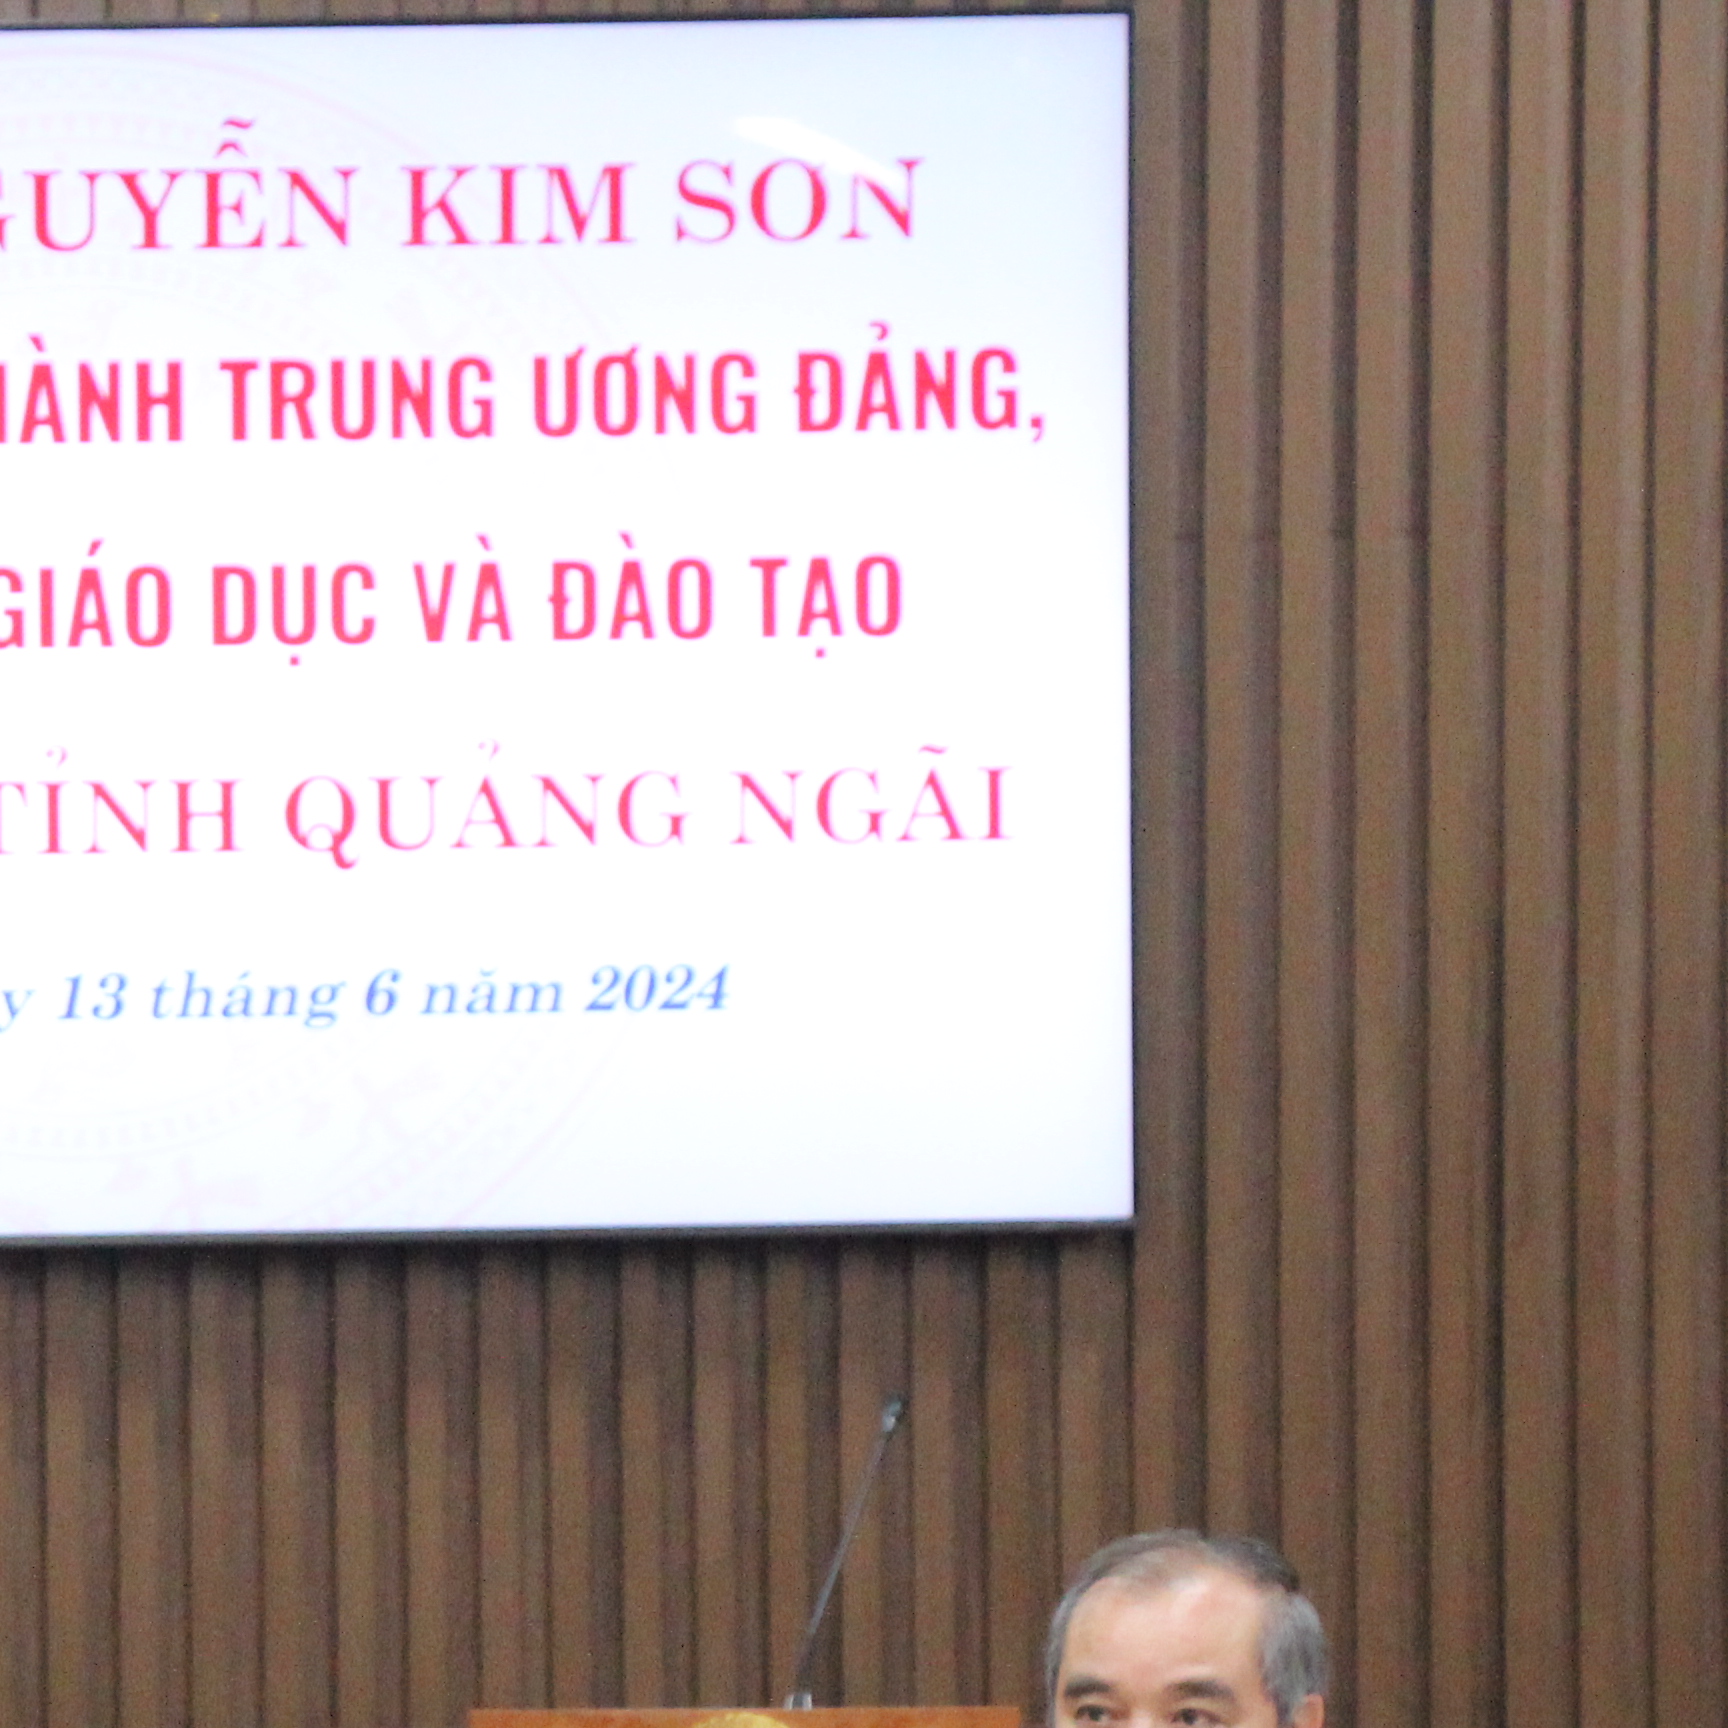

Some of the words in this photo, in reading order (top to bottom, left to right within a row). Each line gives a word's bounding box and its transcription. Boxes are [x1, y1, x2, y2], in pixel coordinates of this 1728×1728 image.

[401, 163, 637, 248] KIM
[220, 357, 495, 440] TRUNG
[533, 346, 758, 436] ƯƠNG
[793, 322, 1047, 442] ĐẢNG,
[211, 562, 377, 666] DỤC
[413, 534, 514, 642] VÀ
[548, 532, 714, 640] ĐÀO
[749, 555, 902, 658] TẠO
[284, 740, 690, 869] QUẢNG
[731, 744, 1014, 844] NGÃI
[58, 972, 126, 1019] 13
[150, 970, 347, 1028] tháng
[364, 968, 401, 1016] 6
[419, 972, 564, 1014] năm
[584, 964, 731, 1012] 2024
